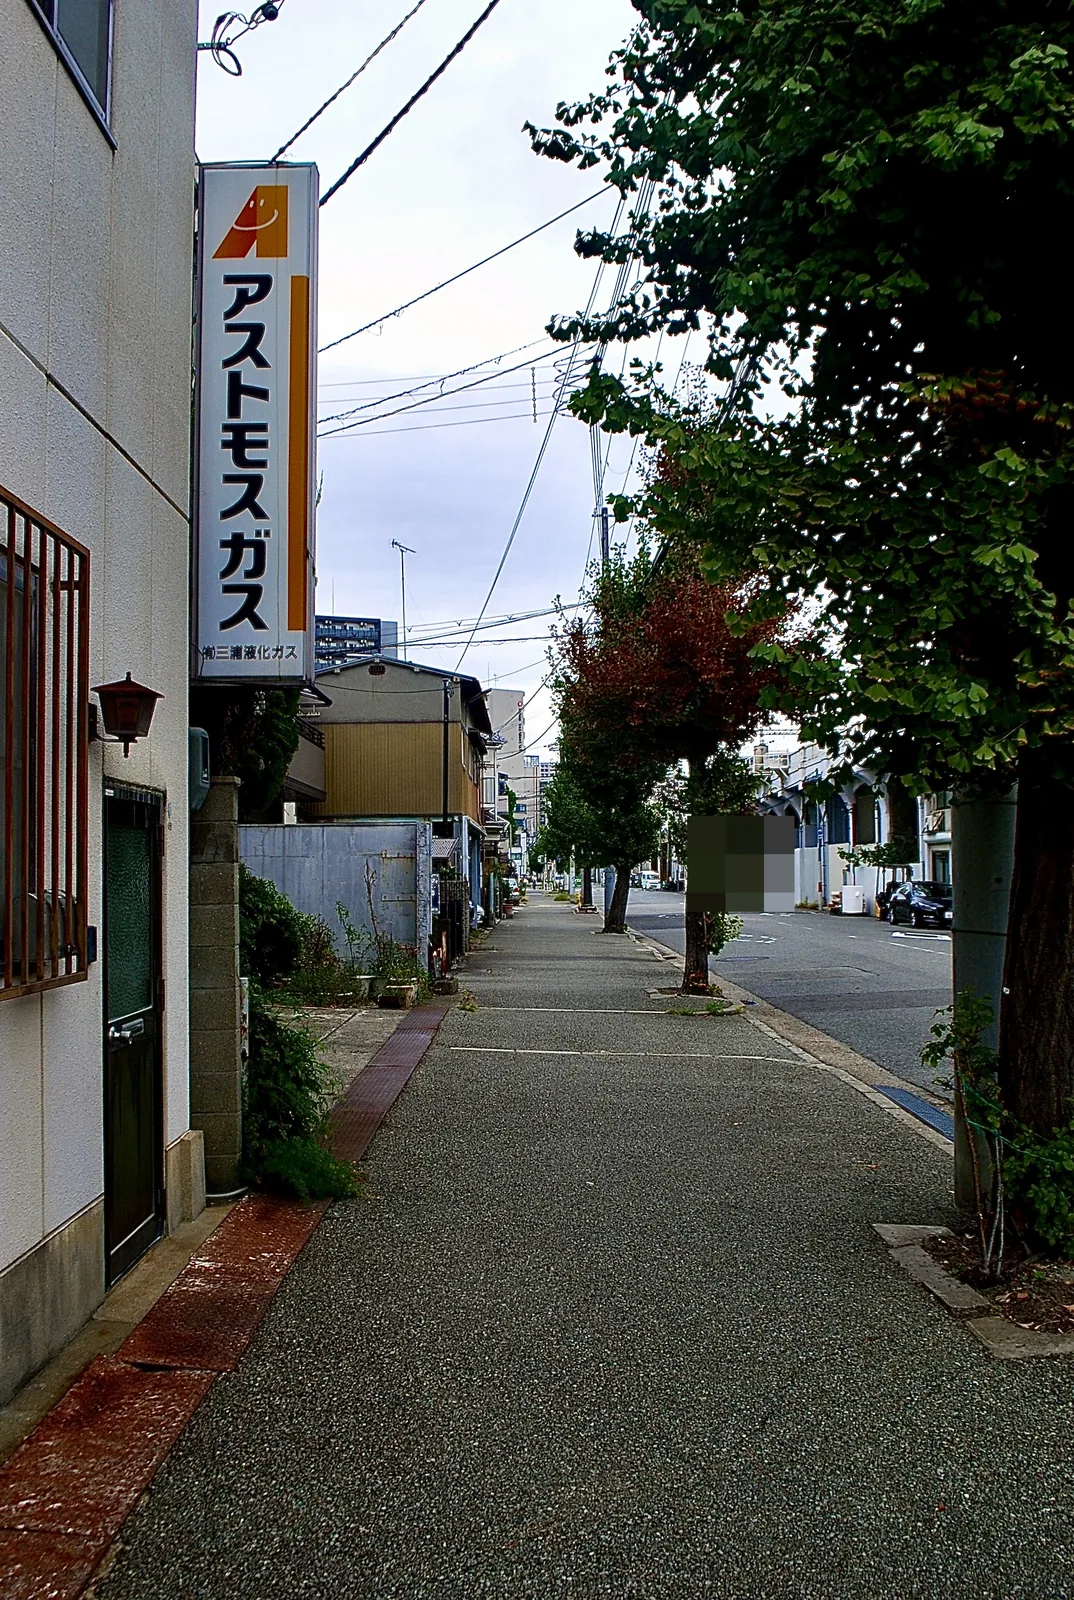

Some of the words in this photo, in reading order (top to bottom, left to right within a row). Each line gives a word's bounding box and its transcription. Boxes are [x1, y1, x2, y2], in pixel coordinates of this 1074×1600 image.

[218, 273, 274, 632] アストモスガス
